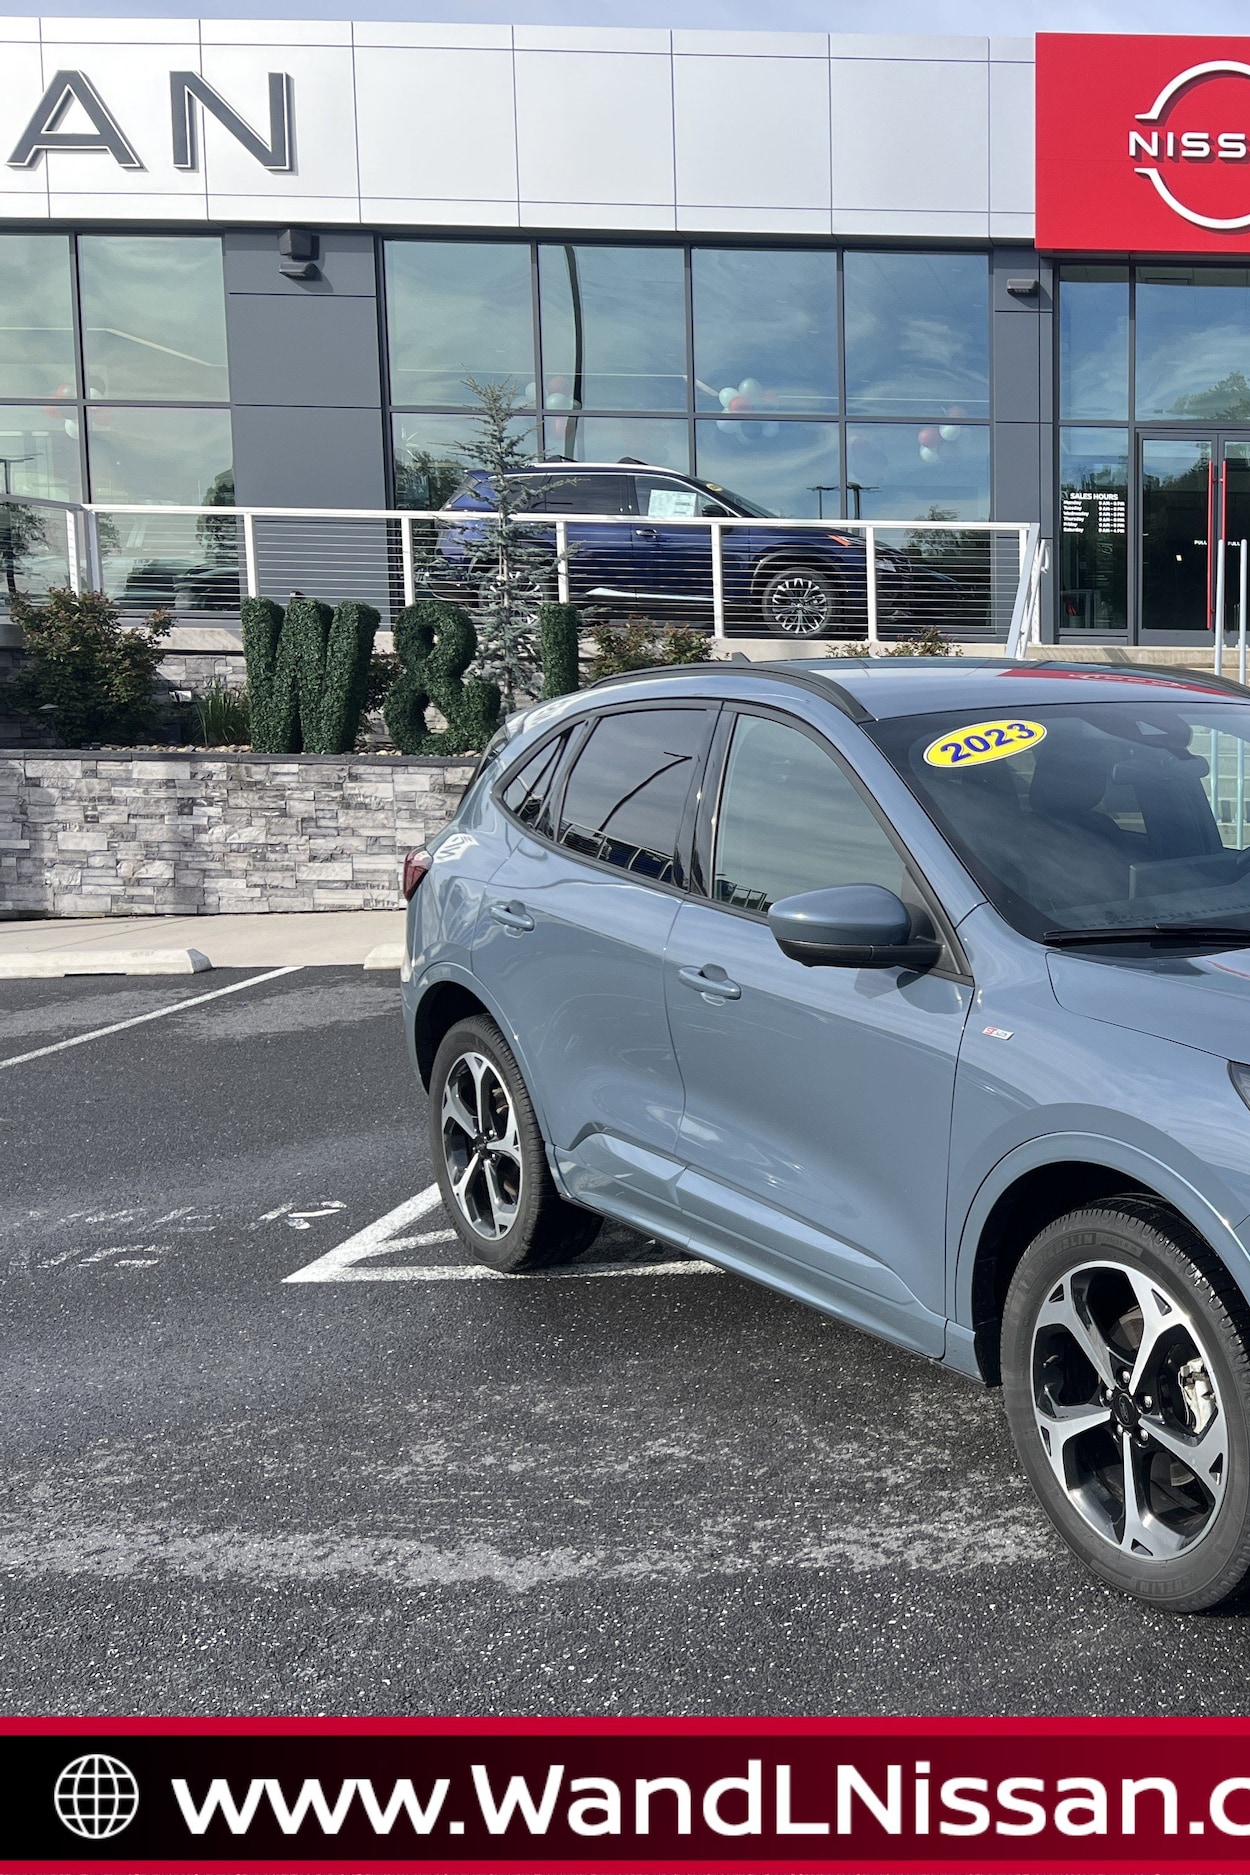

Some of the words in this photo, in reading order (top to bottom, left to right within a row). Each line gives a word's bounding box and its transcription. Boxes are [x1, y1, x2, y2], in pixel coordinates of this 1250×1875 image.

[6, 70, 294, 171] AN
[1070, 492, 1092, 500] SALES
[1093, 493, 1118, 501] HOURS
[940, 723, 1035, 763] 2023
